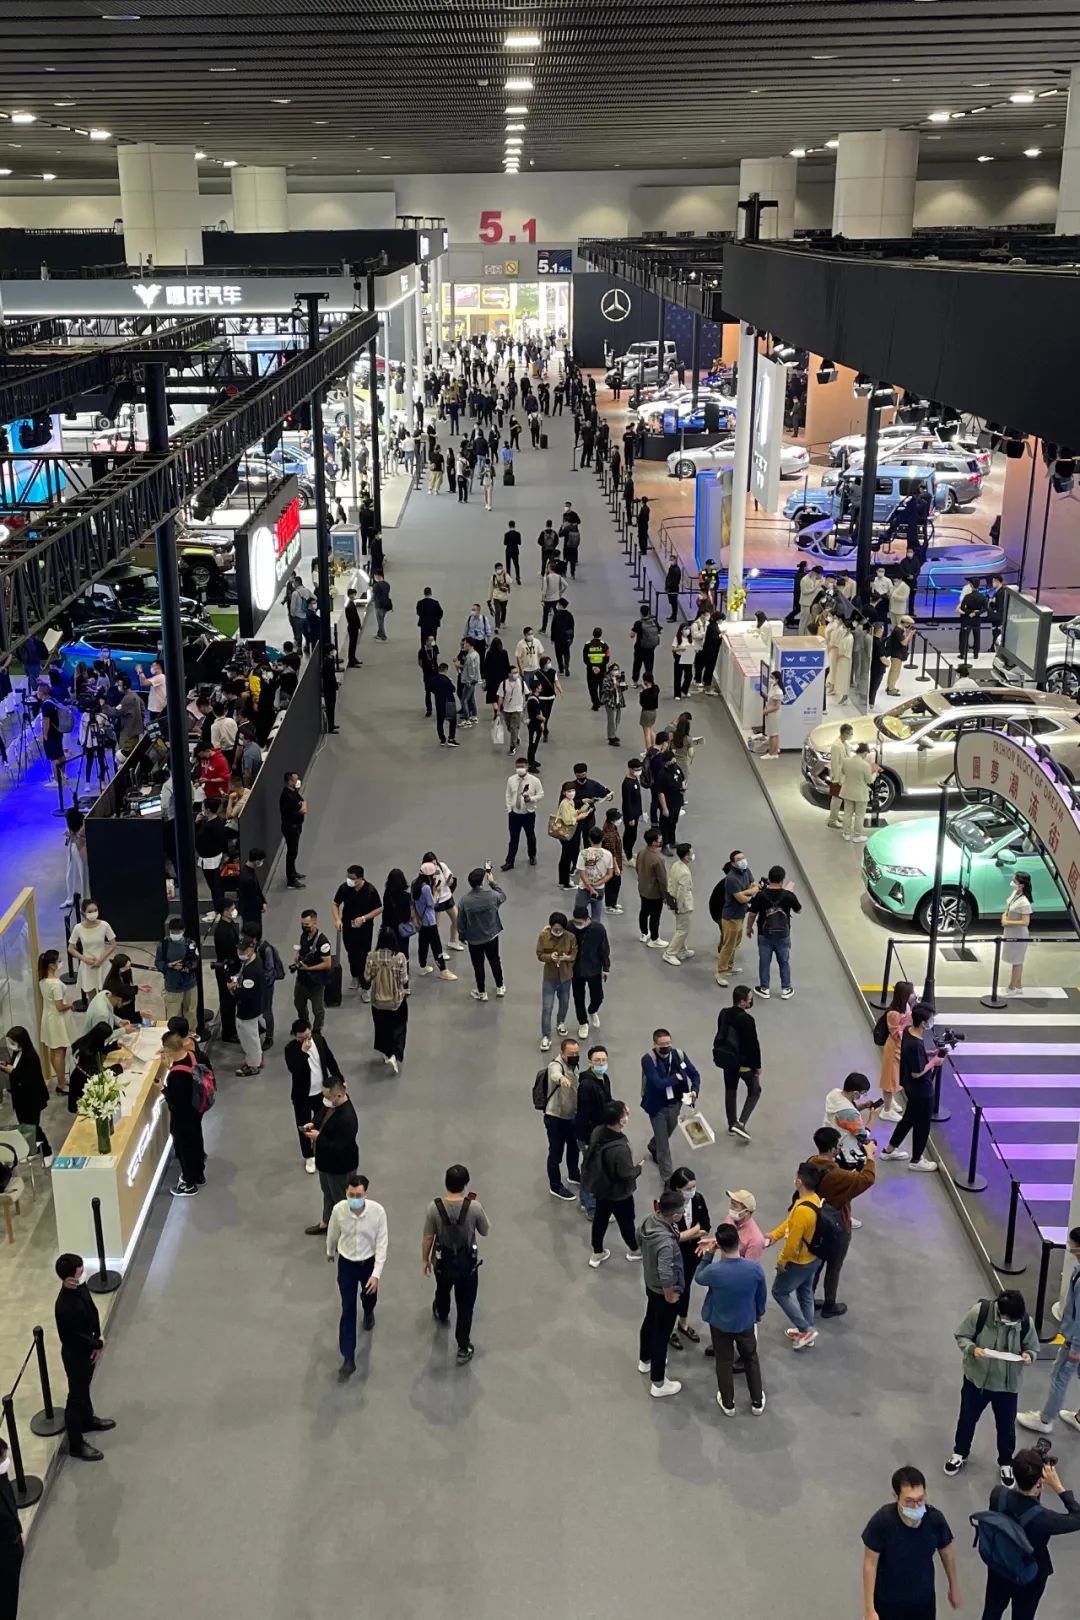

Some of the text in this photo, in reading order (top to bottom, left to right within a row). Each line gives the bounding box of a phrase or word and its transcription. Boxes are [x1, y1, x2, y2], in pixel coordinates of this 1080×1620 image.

[479, 211, 537, 245] 5.1
[538, 259, 558, 274] 5.1
[993, 740, 1064, 822] FASHION BLOCK OF DREAM
